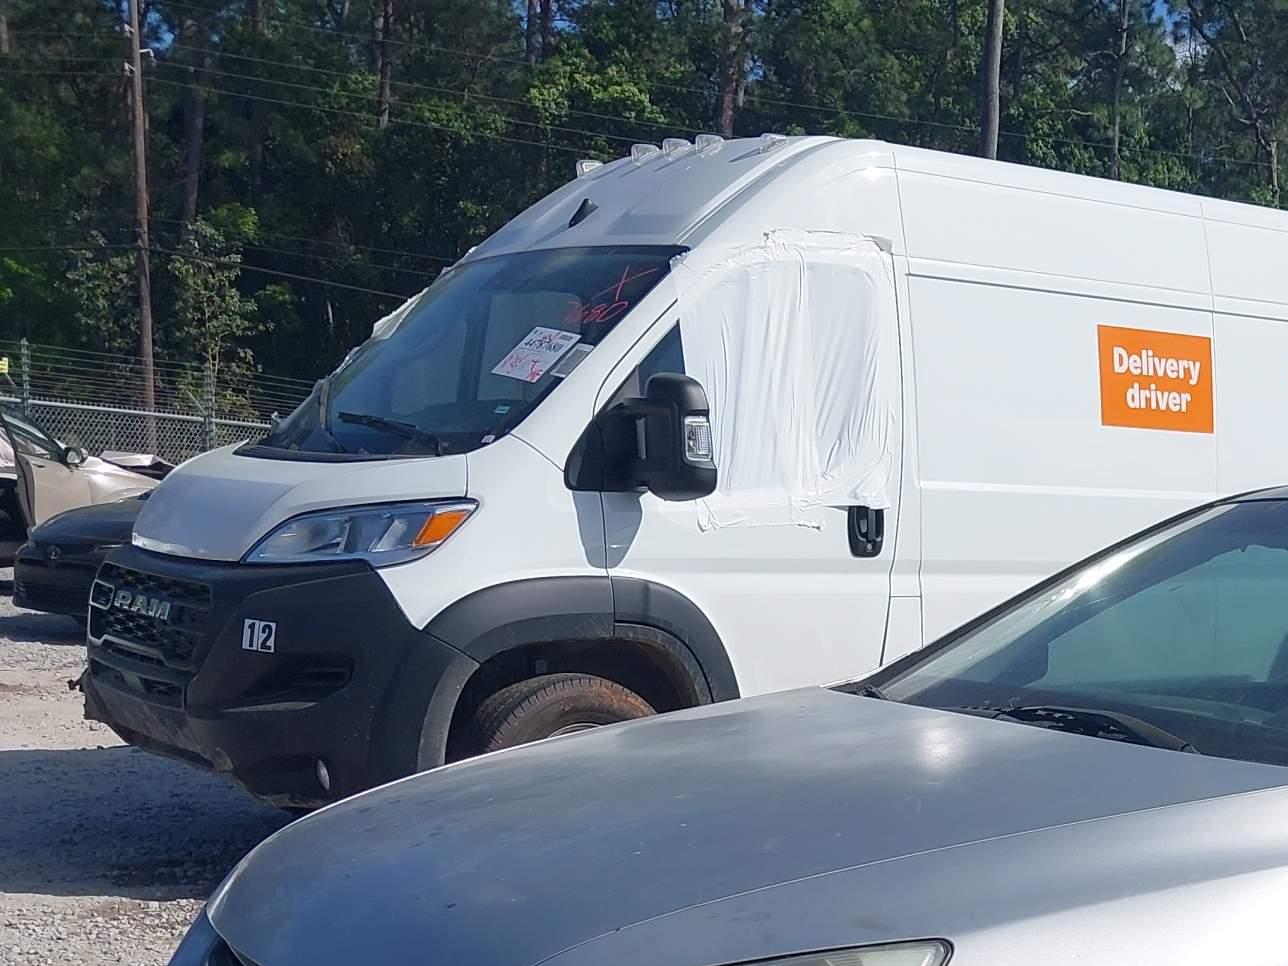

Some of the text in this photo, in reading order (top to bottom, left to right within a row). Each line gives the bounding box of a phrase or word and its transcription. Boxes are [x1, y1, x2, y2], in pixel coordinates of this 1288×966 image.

[1113, 347, 1200, 385] Delivery
[1126, 382, 1191, 412] driver
[114, 590, 171, 620] RAM
